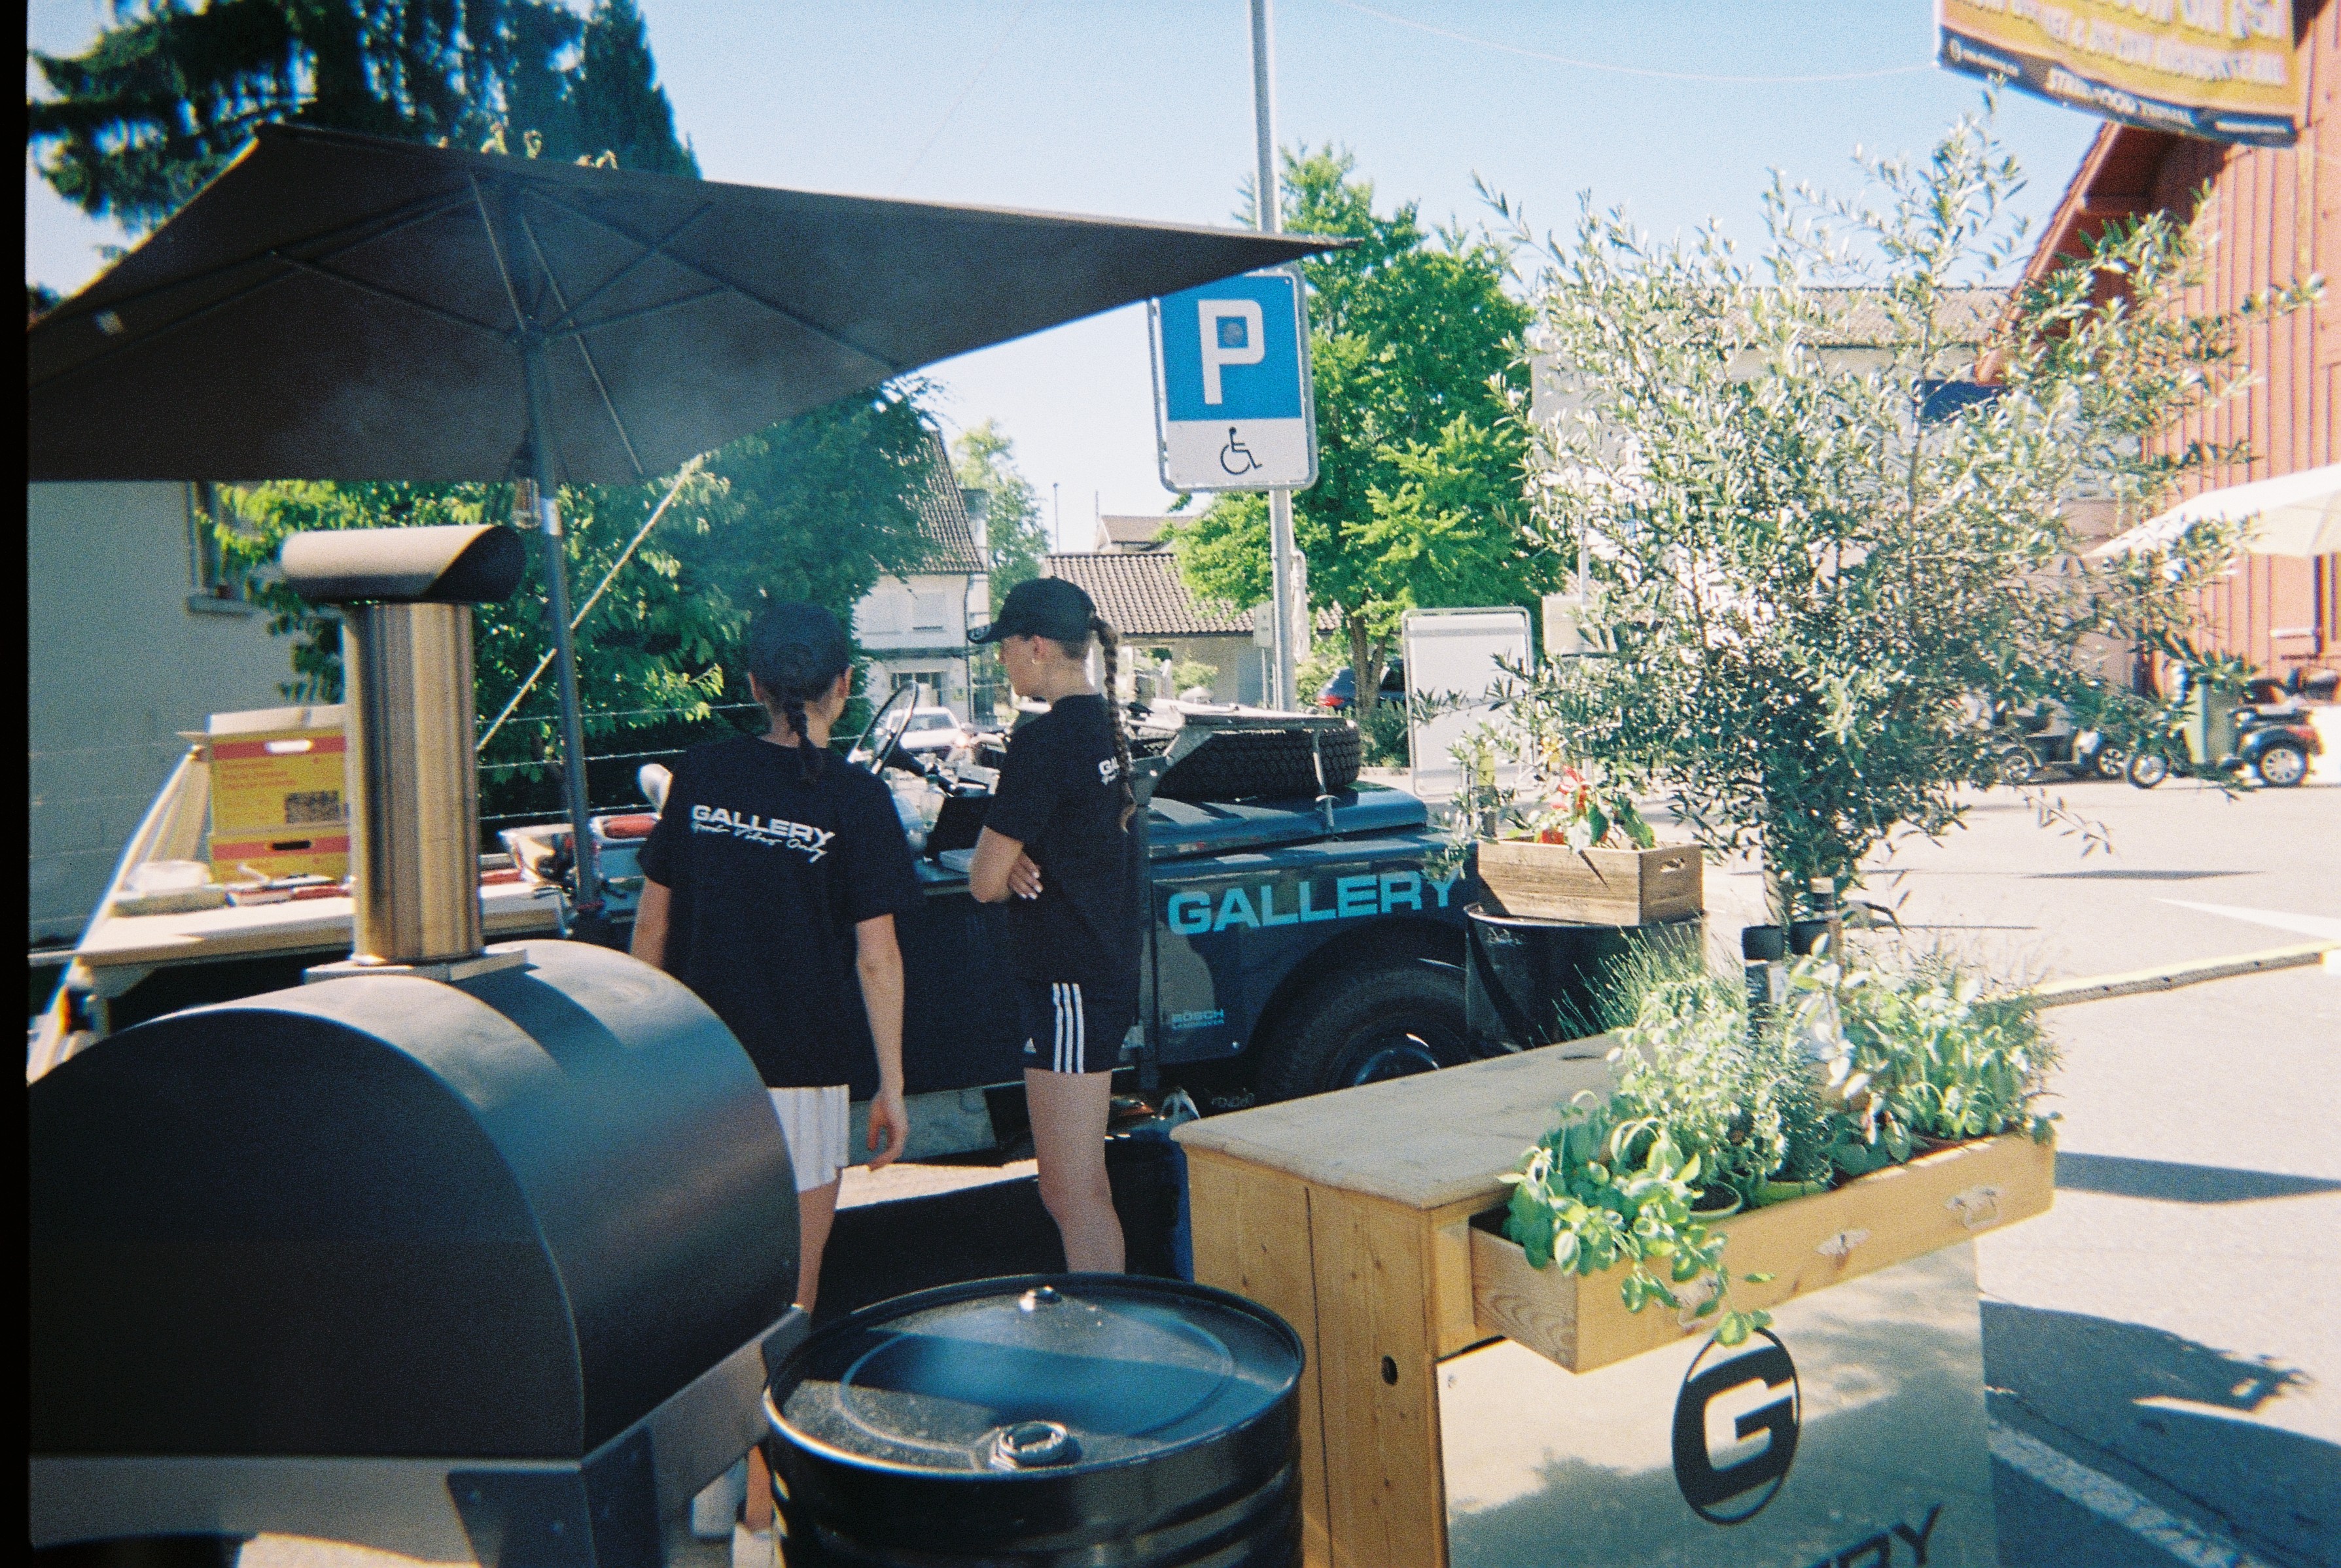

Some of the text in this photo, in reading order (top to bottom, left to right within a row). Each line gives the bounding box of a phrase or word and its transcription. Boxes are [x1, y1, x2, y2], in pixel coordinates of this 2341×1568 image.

[1198, 298, 1265, 405] P
[692, 804, 836, 849] GALLERY
[1168, 868, 1461, 935] GALLERY
[1672, 1344, 1799, 1506] G
